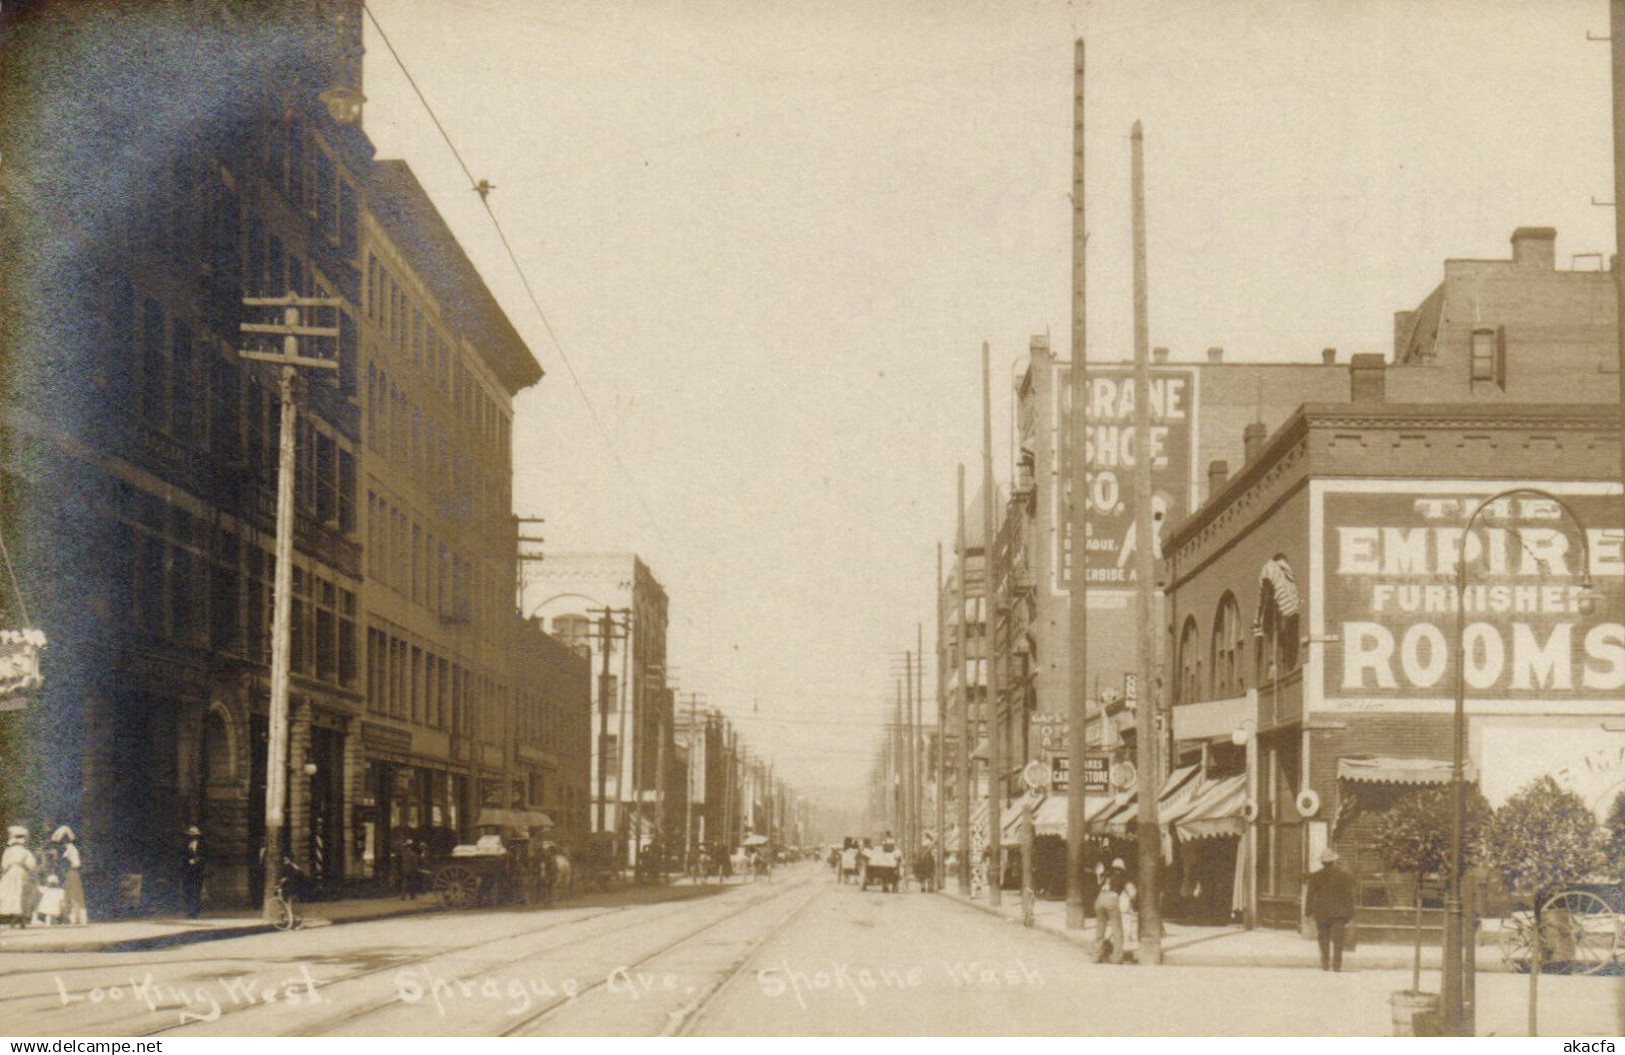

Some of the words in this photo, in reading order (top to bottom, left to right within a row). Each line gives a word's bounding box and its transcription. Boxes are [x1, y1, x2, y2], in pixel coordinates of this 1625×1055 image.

[1414, 498, 1561, 518] THE
[1337, 527, 1625, 576] EMPIRE
[1341, 622, 1625, 690] ROOMS
